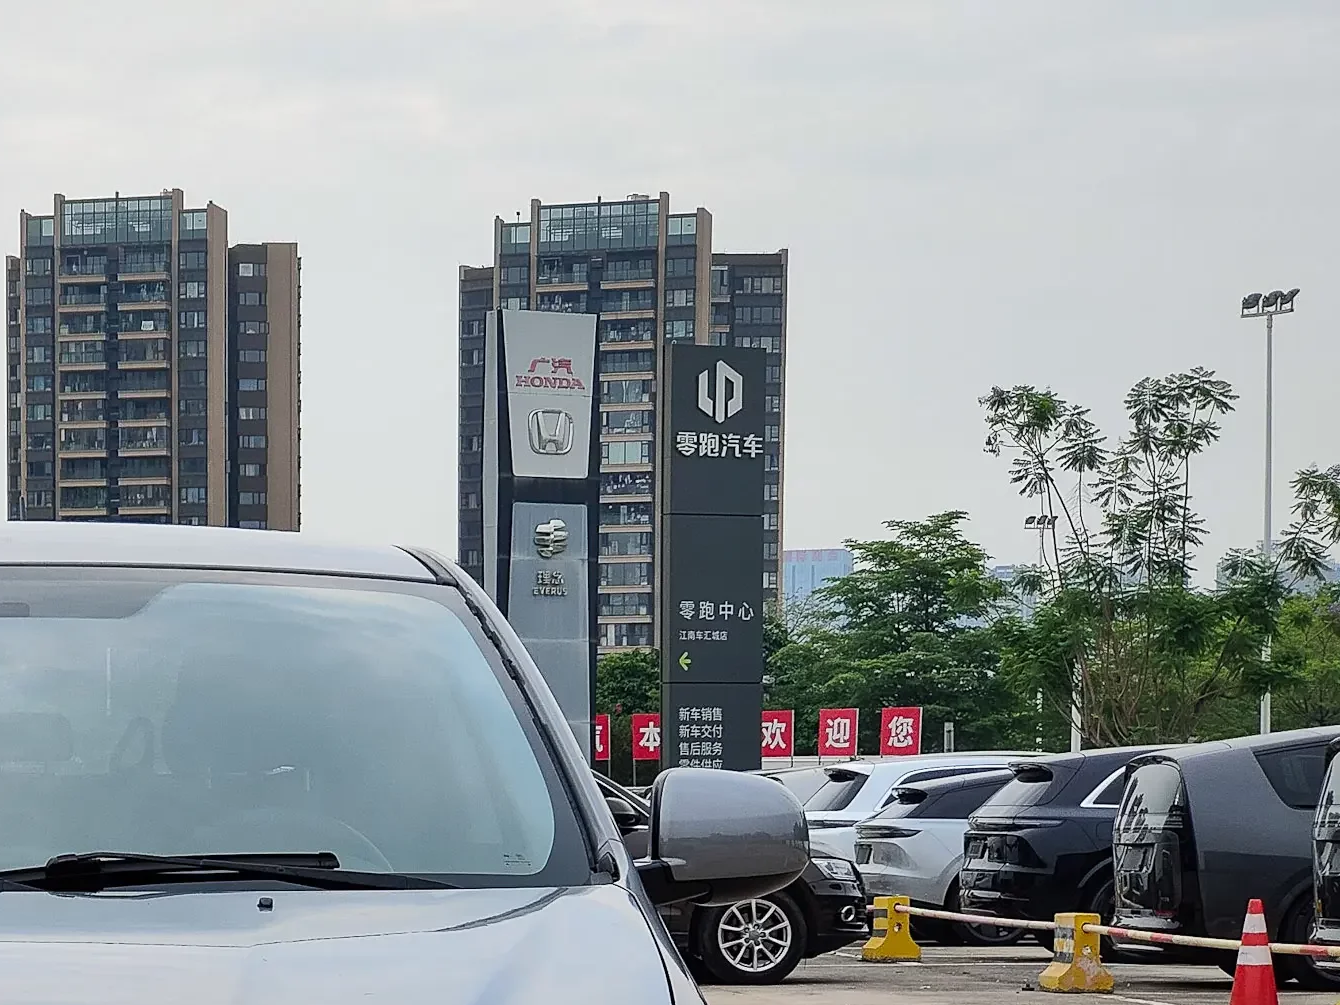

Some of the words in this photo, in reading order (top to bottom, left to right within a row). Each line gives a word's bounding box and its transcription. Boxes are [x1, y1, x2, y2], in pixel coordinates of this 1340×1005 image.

[515, 375, 586, 390] HONDA
[676, 431, 764, 458] 零跑汽车
[532, 586, 568, 596] EVERUS
[679, 600, 755, 620] 零跑中心
[679, 630, 728, 641] 江南车汇城店
[678, 707, 723, 721] 新车销售
[638, 721, 661, 752] 本
[678, 724, 723, 738] 新车交付
[678, 741, 723, 756] 售后服务
